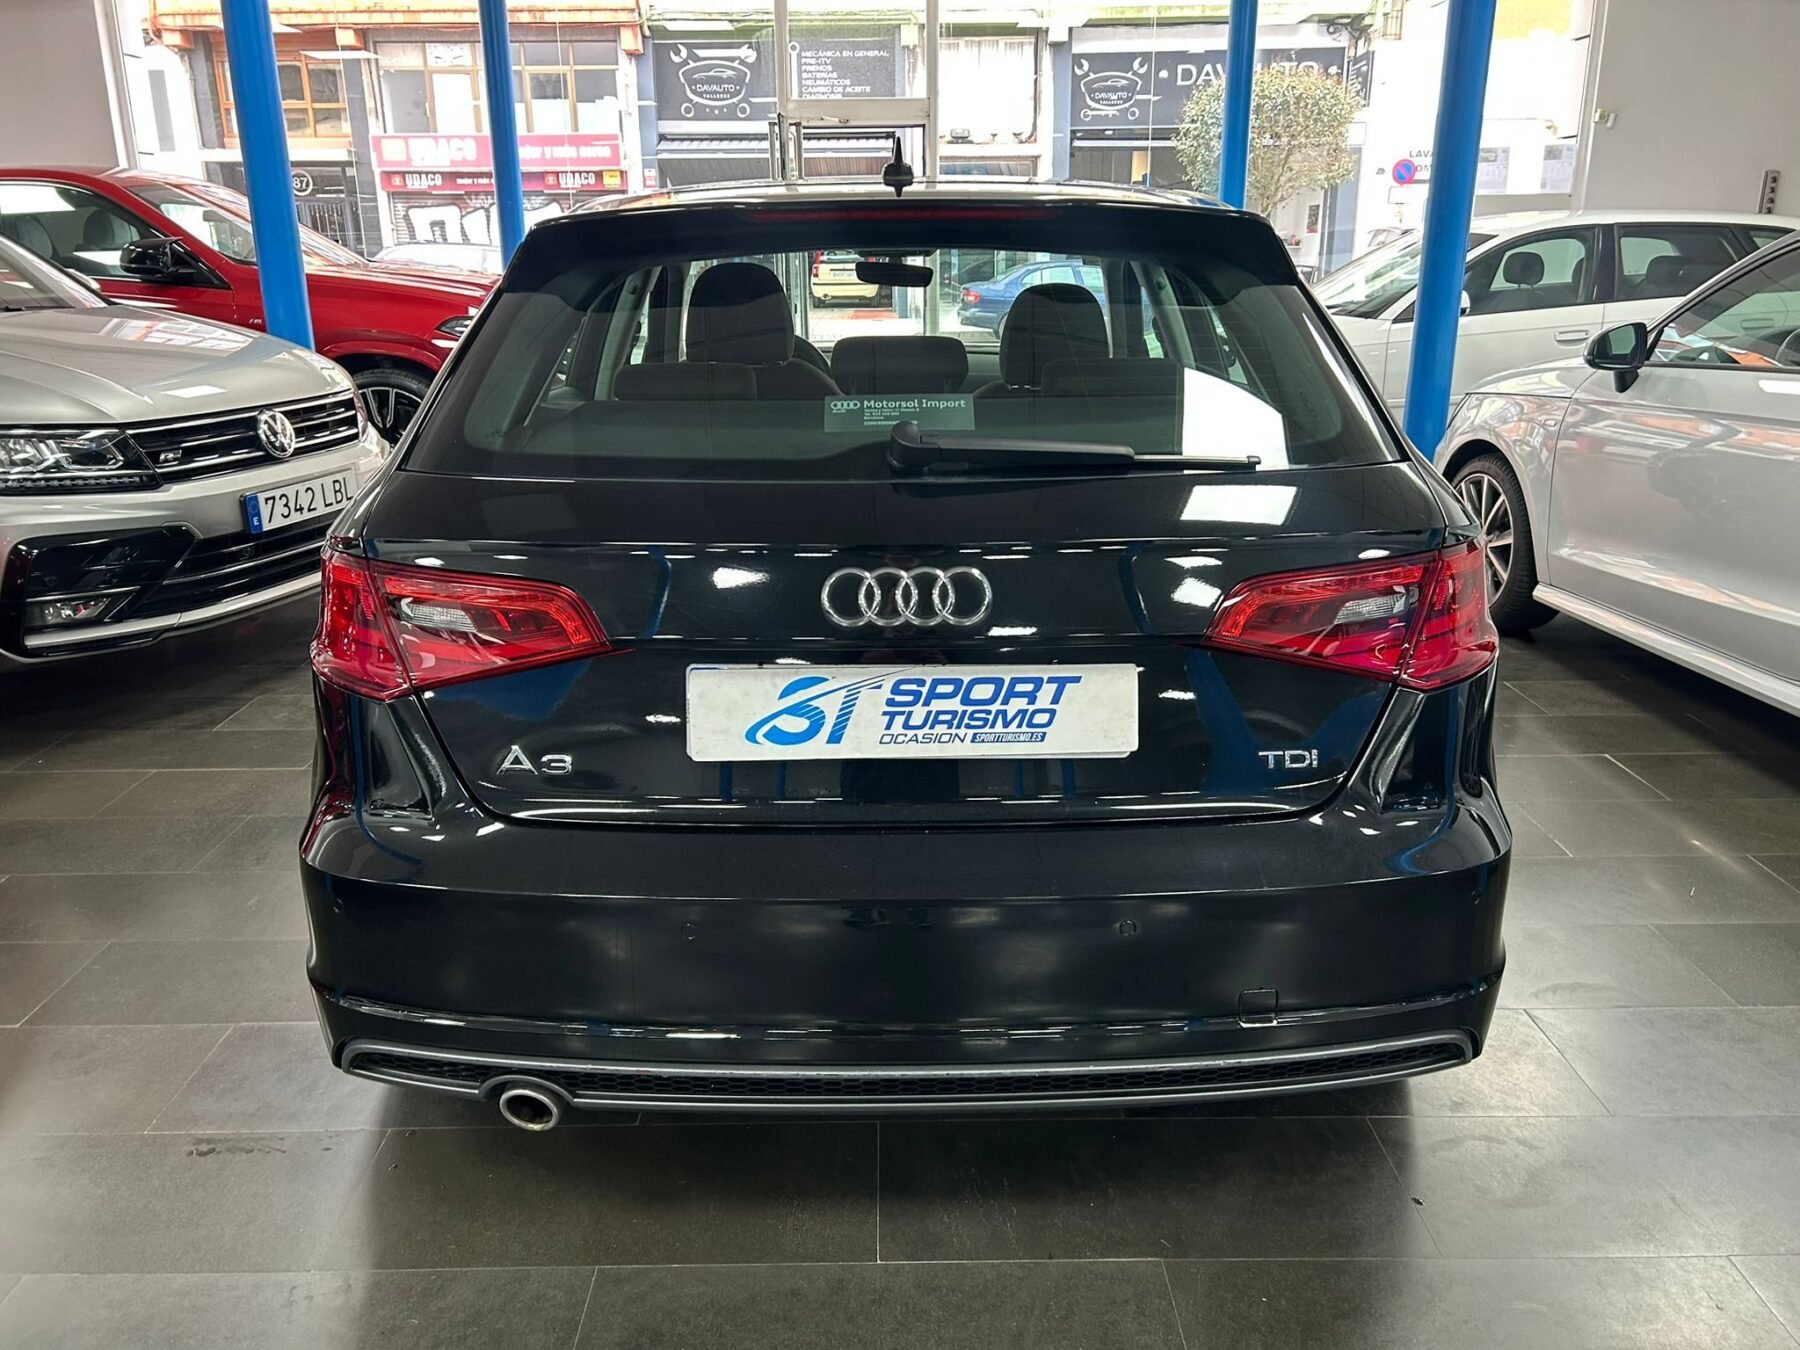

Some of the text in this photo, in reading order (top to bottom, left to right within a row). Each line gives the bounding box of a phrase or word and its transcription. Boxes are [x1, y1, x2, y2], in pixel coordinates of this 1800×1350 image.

[801, 49, 841, 57] MECÁNICA
[802, 71, 838, 79] BATERÍAS
[696, 84, 735, 92] DAVAUTO
[802, 78, 851, 86] NEUMÁTICOS
[1094, 91, 1128, 99] DAVAUTO
[292, 177, 308, 189] 87
[405, 172, 443, 187] UDACO
[558, 172, 596, 186] UDACO
[864, 398, 966, 410] Motorsol Import
[264, 477, 355, 524] 7342 LBL
[252, 516, 260, 526] E
[885, 676, 1082, 708] SPORT
[881, 708, 1058, 731] TURISMO
[879, 731, 1043, 745] OCASION SPORTTURISMO.ES
[496, 744, 572, 775] A3
[1258, 749, 1318, 769] TDI
